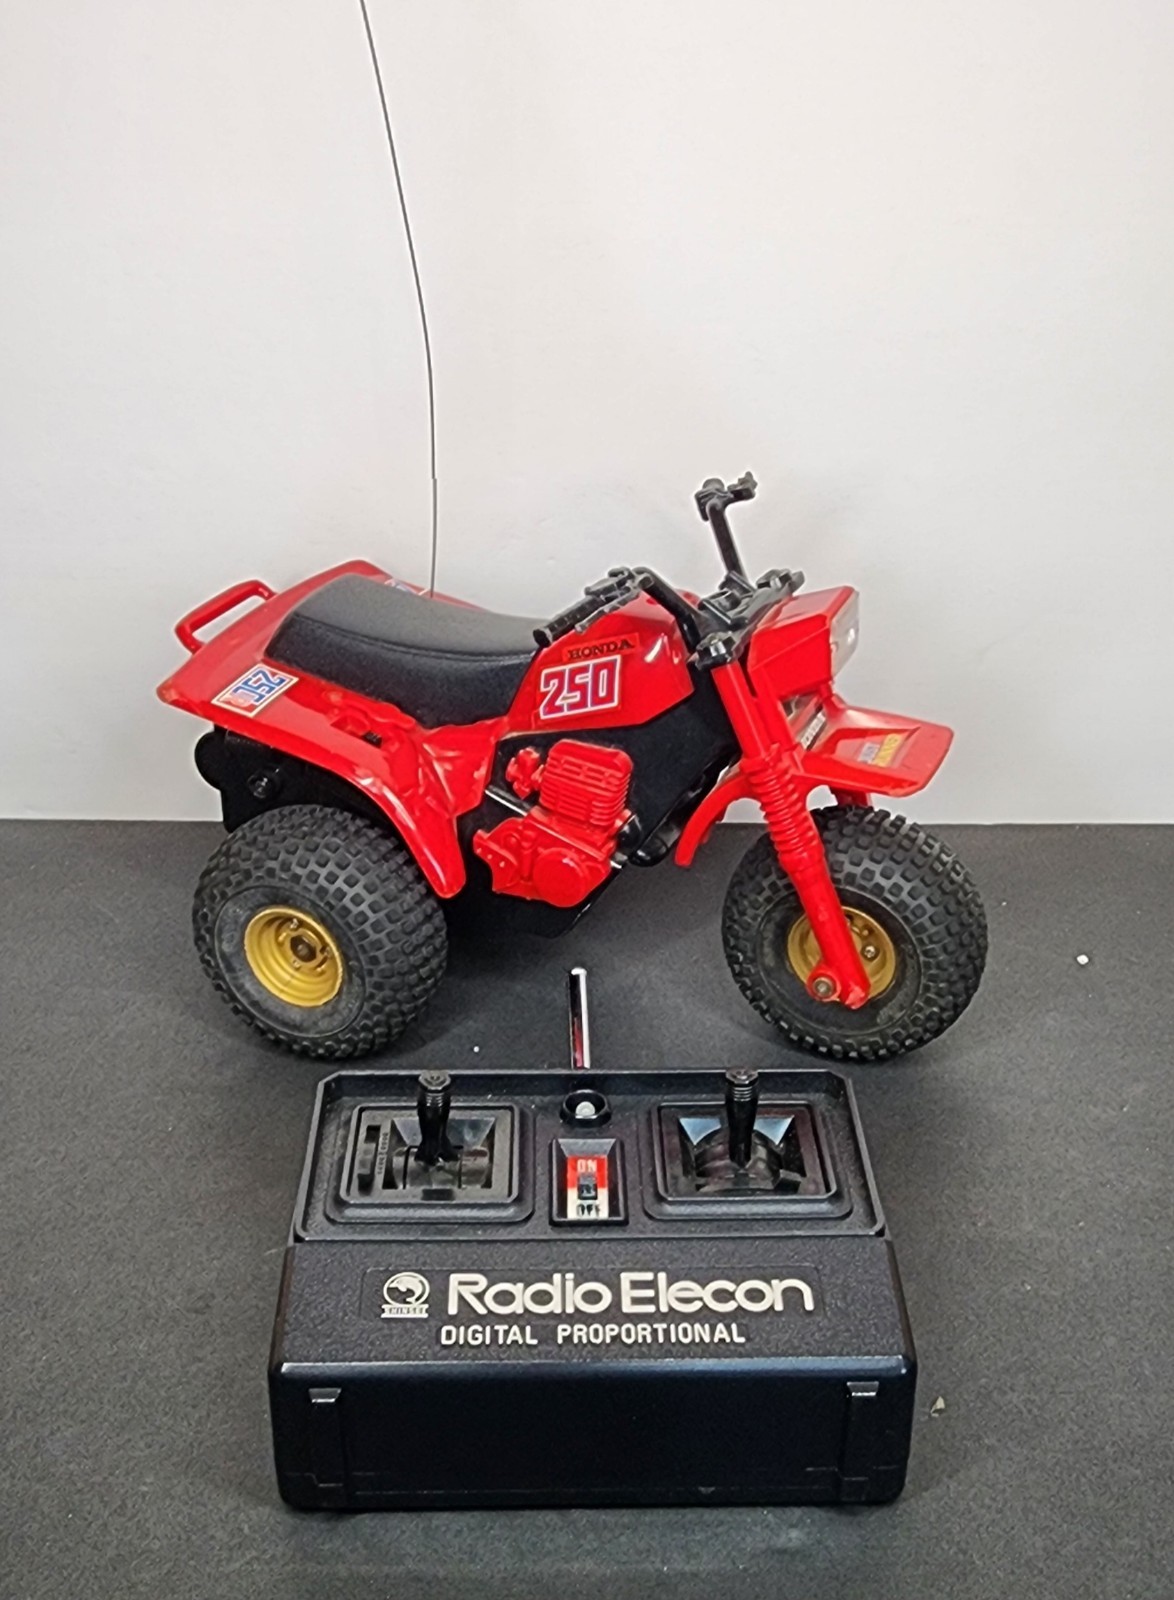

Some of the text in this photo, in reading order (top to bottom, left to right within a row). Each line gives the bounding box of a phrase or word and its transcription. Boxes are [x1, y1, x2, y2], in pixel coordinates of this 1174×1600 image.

[567, 638, 635, 659] HONDA
[539, 655, 622, 720] 250
[577, 1159, 598, 1173] ON
[448, 1271, 815, 1315] Radio Elecon
[440, 1322, 746, 1346] DIGITAL PROPORTIONAL
